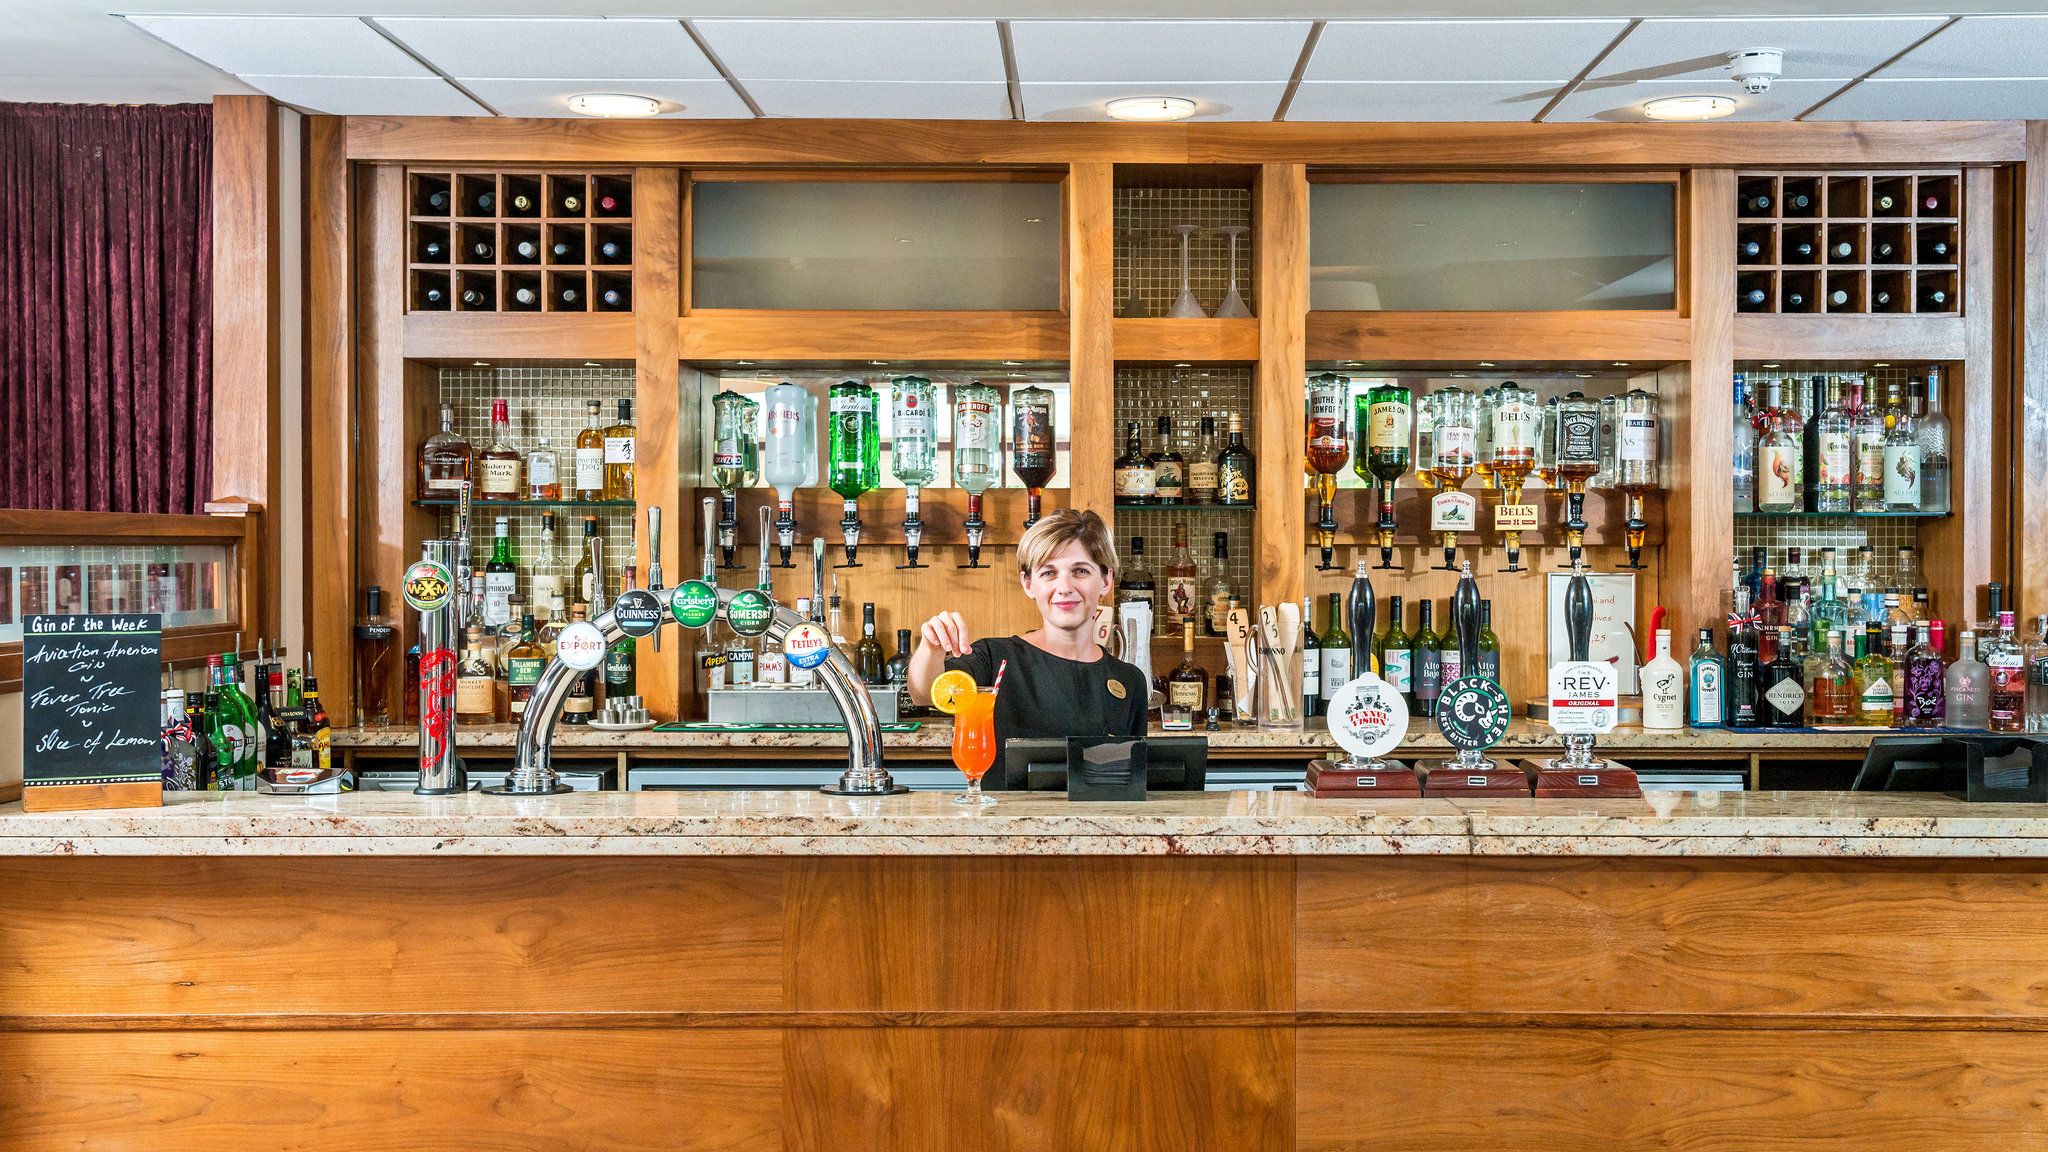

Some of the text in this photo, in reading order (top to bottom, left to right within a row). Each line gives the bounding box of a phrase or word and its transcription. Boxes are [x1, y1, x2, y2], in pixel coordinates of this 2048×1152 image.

[1374, 405, 1405, 415] JAMESON
[1500, 411, 1531, 421] BELL'S
[1624, 438, 1635, 446] VS
[1500, 507, 1534, 516] BELL'S
[673, 592, 716, 608] Carlsberg
[1599, 594, 1615, 604] and
[616, 608, 659, 619] GUINNESS
[730, 609, 771, 619] SOMERSBY
[1229, 612, 1239, 625] 4
[1263, 611, 1272, 625] 2
[32, 616, 148, 632] Gin of the Week
[1098, 625, 1108, 638] 6
[1238, 625, 1247, 638] 5
[791, 638, 823, 649] TETLEY'S
[26, 642, 99, 663] Aviation
[512, 660, 541, 668] TULLAMORE
[798, 654, 820, 664] EXTRA
[1423, 661, 1440, 669] Alto
[759, 661, 783, 672] PIMM'S
[1423, 669, 1440, 679] Bajo
[1563, 676, 1606, 690] REV
[31, 681, 135, 709] Fever Tree
[1440, 678, 1491, 706] BLACK
[1653, 693, 1677, 703] Cygnet
[1955, 693, 1975, 701] GIN
[1916, 696, 1938, 709] Boë
[65, 701, 116, 717] Tonic
[1348, 710, 1388, 722] TUNNEL
[1352, 717, 1386, 727] VISION
[1440, 711, 1452, 732] BEST
[1485, 692, 1509, 744] SHEEP
[36, 729, 156, 755] Slice of Lemon
[1449, 731, 1479, 747] BITTER
